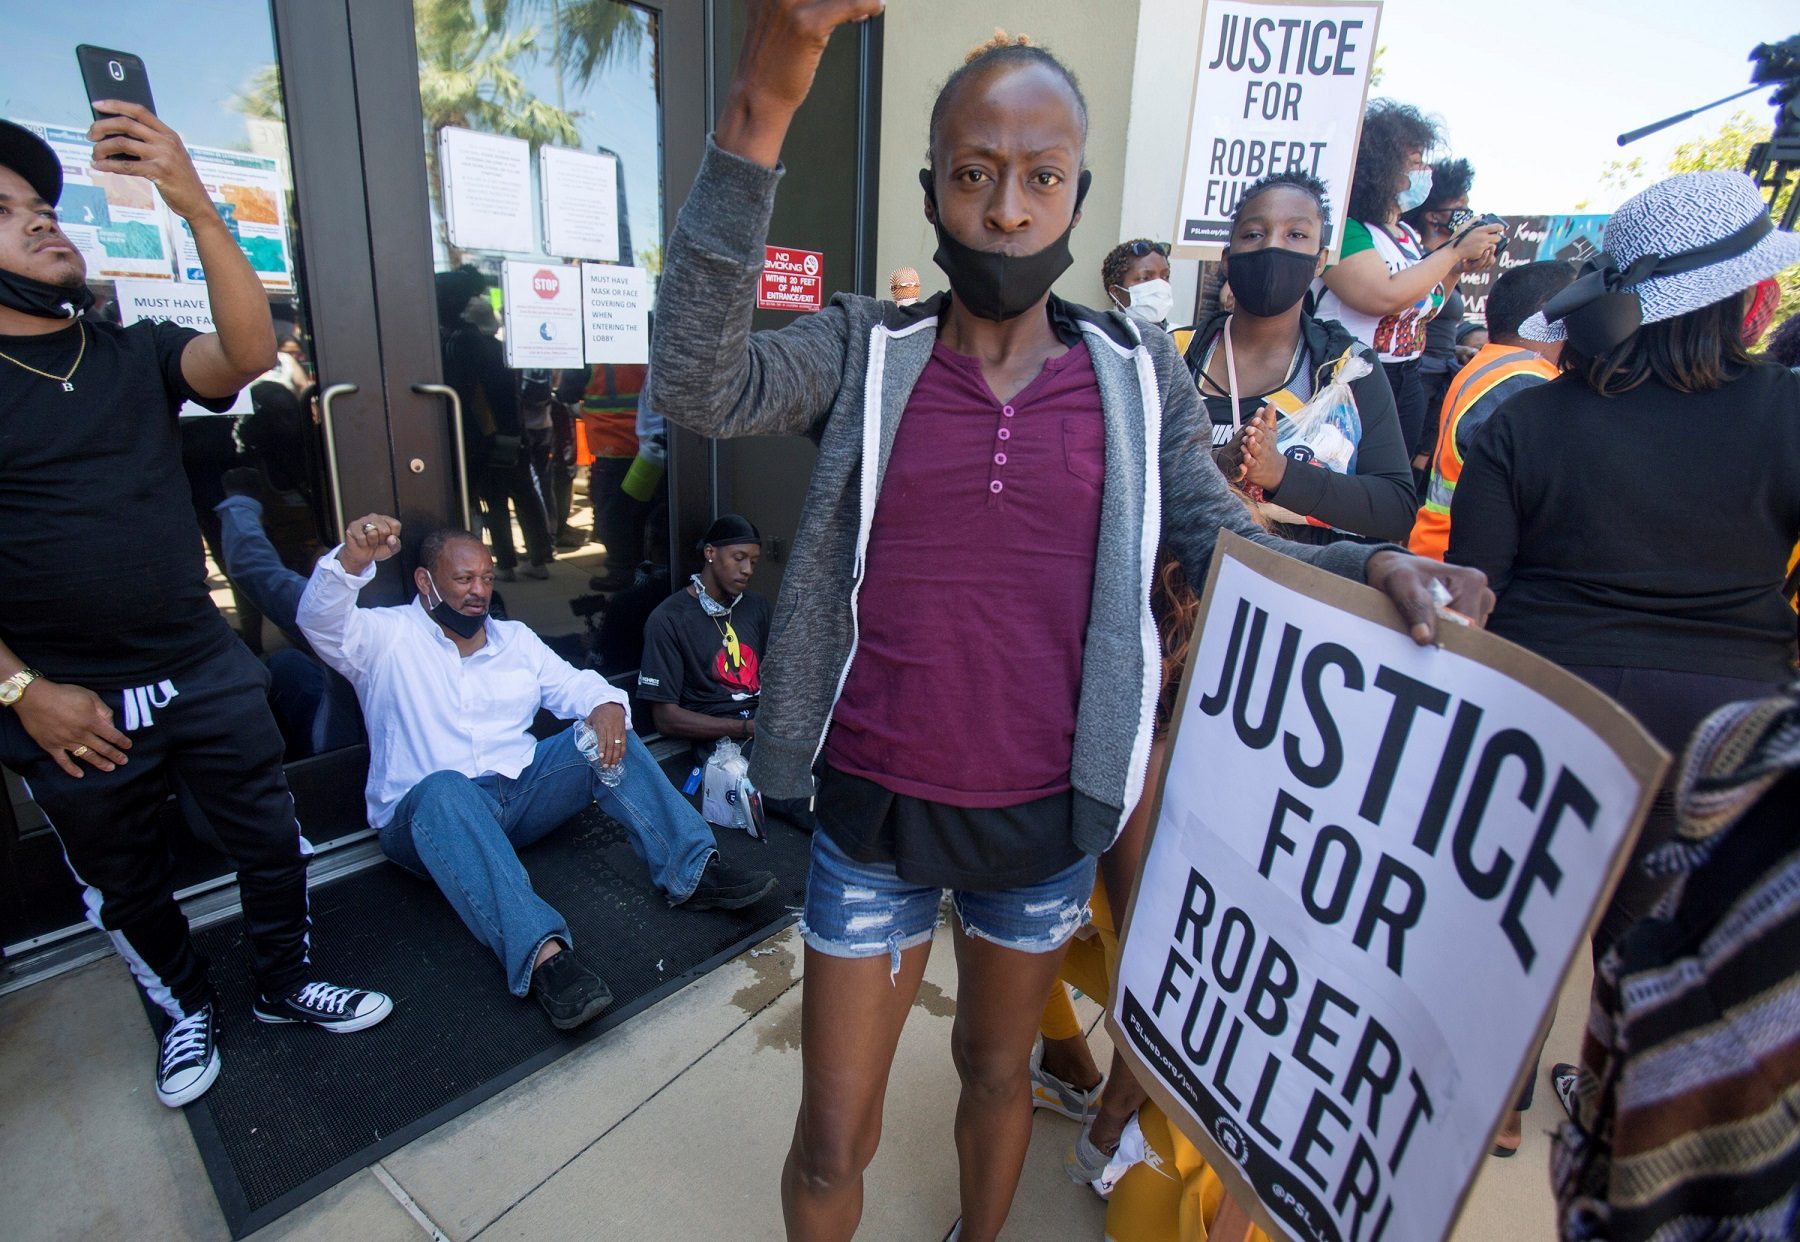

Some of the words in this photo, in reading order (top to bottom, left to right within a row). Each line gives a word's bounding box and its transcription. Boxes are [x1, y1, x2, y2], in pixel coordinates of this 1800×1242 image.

[1208, 14, 1363, 76] JUSTICE
[1243, 80, 1303, 121] FOR
[1209, 138, 1327, 177] ROBERT
[775, 252, 790, 261] NO
[764, 260, 803, 271] SMOKING
[534, 278, 558, 291] STOP
[590, 275, 610, 284] MUST
[611, 277, 629, 285] HAVE
[766, 274, 787, 283] WITHIN
[789, 277, 798, 285] 20
[800, 278, 816, 286] FEET
[591, 287, 611, 295] MASK
[622, 290, 638, 298] FACE
[778, 284, 787, 292] OF
[790, 285, 804, 293] ANY
[767, 292, 814, 302] ENTRANCE/EXIT
[134, 297, 169, 308] MUST
[173, 299, 206, 309] HAVE
[591, 300, 625, 308] COVERING
[626, 301, 637, 309] ON
[176, 315, 194, 325] OR
[592, 311, 613, 319] WHEN
[592, 324, 624, 332] ENTERING
[1198, 597, 1600, 976] JUSTICE
[1258, 787, 1427, 978] FOR
[1174, 865, 1434, 1178] ROBERT
[1129, 1013, 1199, 1103] PSLweb.org/join
